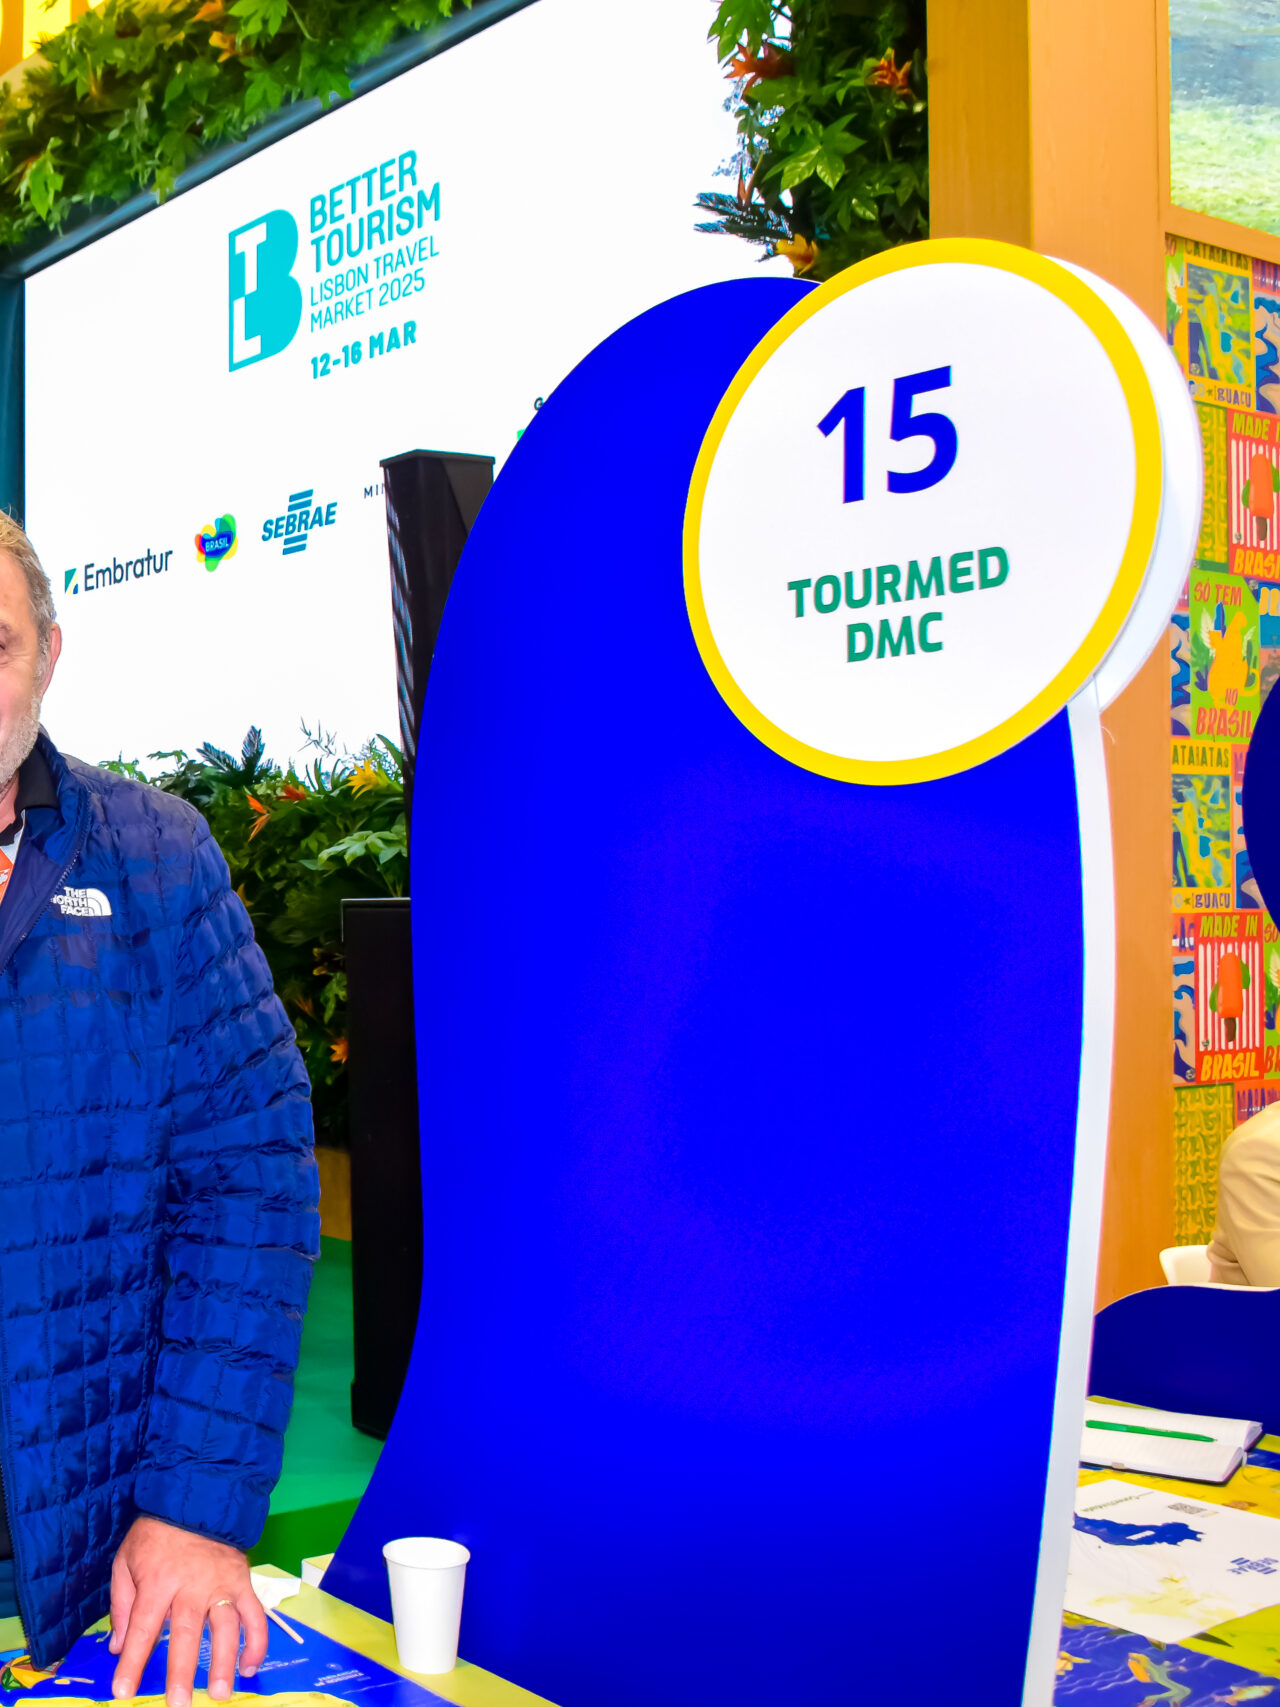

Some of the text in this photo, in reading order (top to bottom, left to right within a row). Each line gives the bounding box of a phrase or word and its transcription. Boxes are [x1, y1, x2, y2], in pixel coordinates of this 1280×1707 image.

[310, 149, 418, 234] BETTER
[310, 181, 441, 273] TOURISM
[310, 234, 440, 307] LISBON TRAVEL
[310, 267, 426, 333] MARKET 2025
[310, 320, 417, 380] 12-16 MAR
[816, 365, 960, 504] 15
[1232, 412, 1271, 441] MADE
[261, 501, 338, 541] SEBRAE
[204, 536, 230, 552] BRASIL
[84, 547, 173, 592] Embratur
[1233, 548, 1280, 580] BRASI
[787, 546, 1010, 618] TOURMED
[1216, 583, 1242, 607] TEM
[847, 611, 943, 663] DMC
[1225, 688, 1239, 706] NO
[1195, 706, 1252, 738] BRASIL
[50, 895, 88, 908] NORTH
[64, 886, 86, 898] THE
[60, 905, 89, 917] FACE
[1200, 914, 1240, 938] MADE
[1246, 914, 1258, 937] IN
[1201, 1051, 1260, 1082] BRASIL
